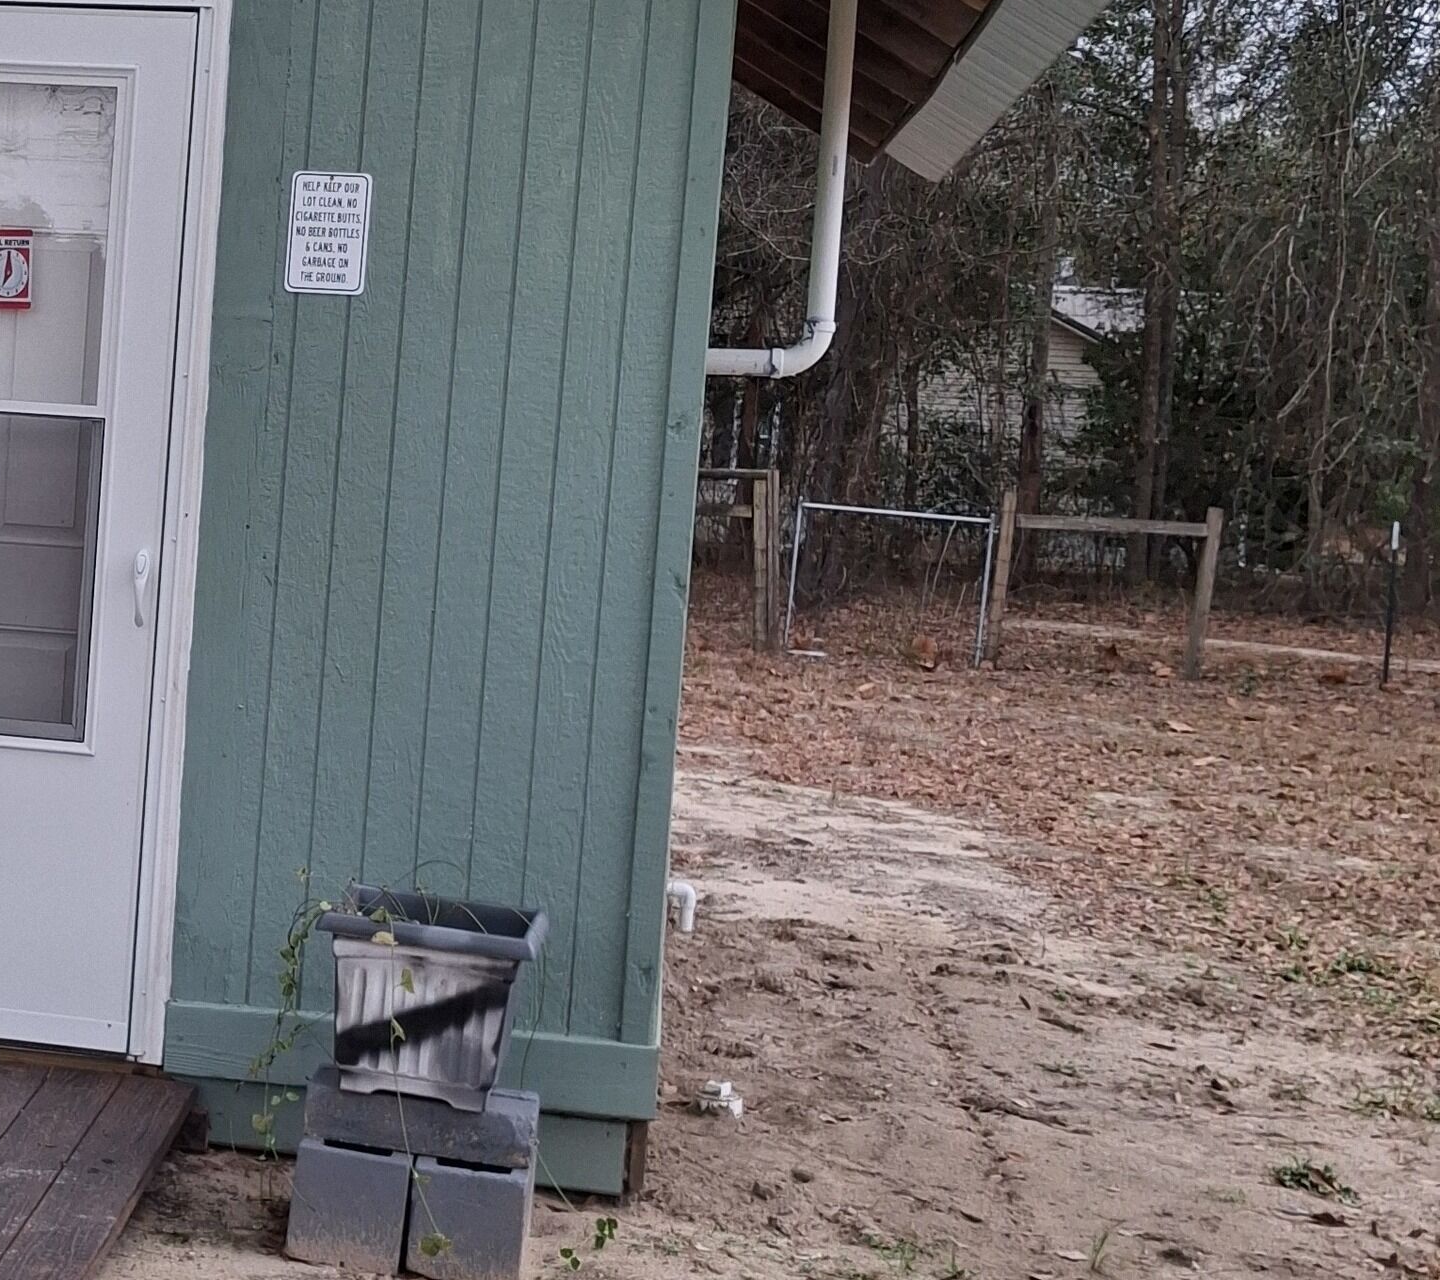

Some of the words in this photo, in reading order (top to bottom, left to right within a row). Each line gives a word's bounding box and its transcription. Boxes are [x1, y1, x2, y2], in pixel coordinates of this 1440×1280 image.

[302, 181, 321, 191] HELP
[323, 182, 341, 192] KEEP
[344, 183, 360, 193] OUR
[302, 197, 316, 207] LOT
[346, 199, 358, 209] NO
[295, 211, 335, 223] CIGARETTE
[296, 226, 306, 237] NO
[308, 227, 326, 237] BEER
[328, 228, 360, 239] BOTTLES
[337, 243, 348, 254] NO
[302, 257, 336, 268] GARBAGE
[338, 258, 349, 268] ON
[300, 272, 313, 282] THE
